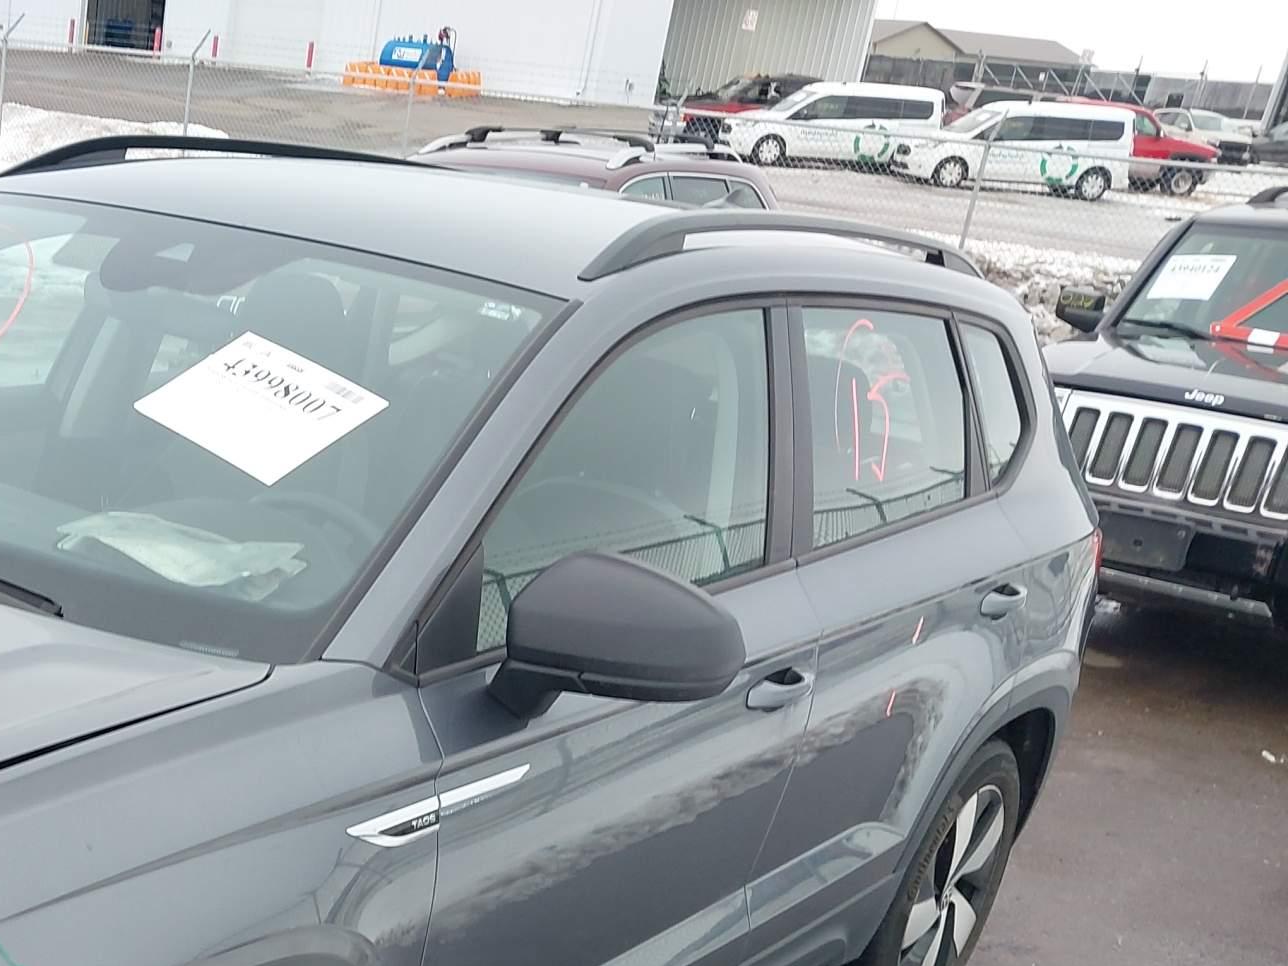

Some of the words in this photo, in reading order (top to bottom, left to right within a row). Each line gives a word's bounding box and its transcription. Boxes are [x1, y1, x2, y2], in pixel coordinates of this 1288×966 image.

[223, 357, 343, 421] 43998007
[1184, 388, 1225, 407] Jeep
[411, 812, 436, 830] TAOS
